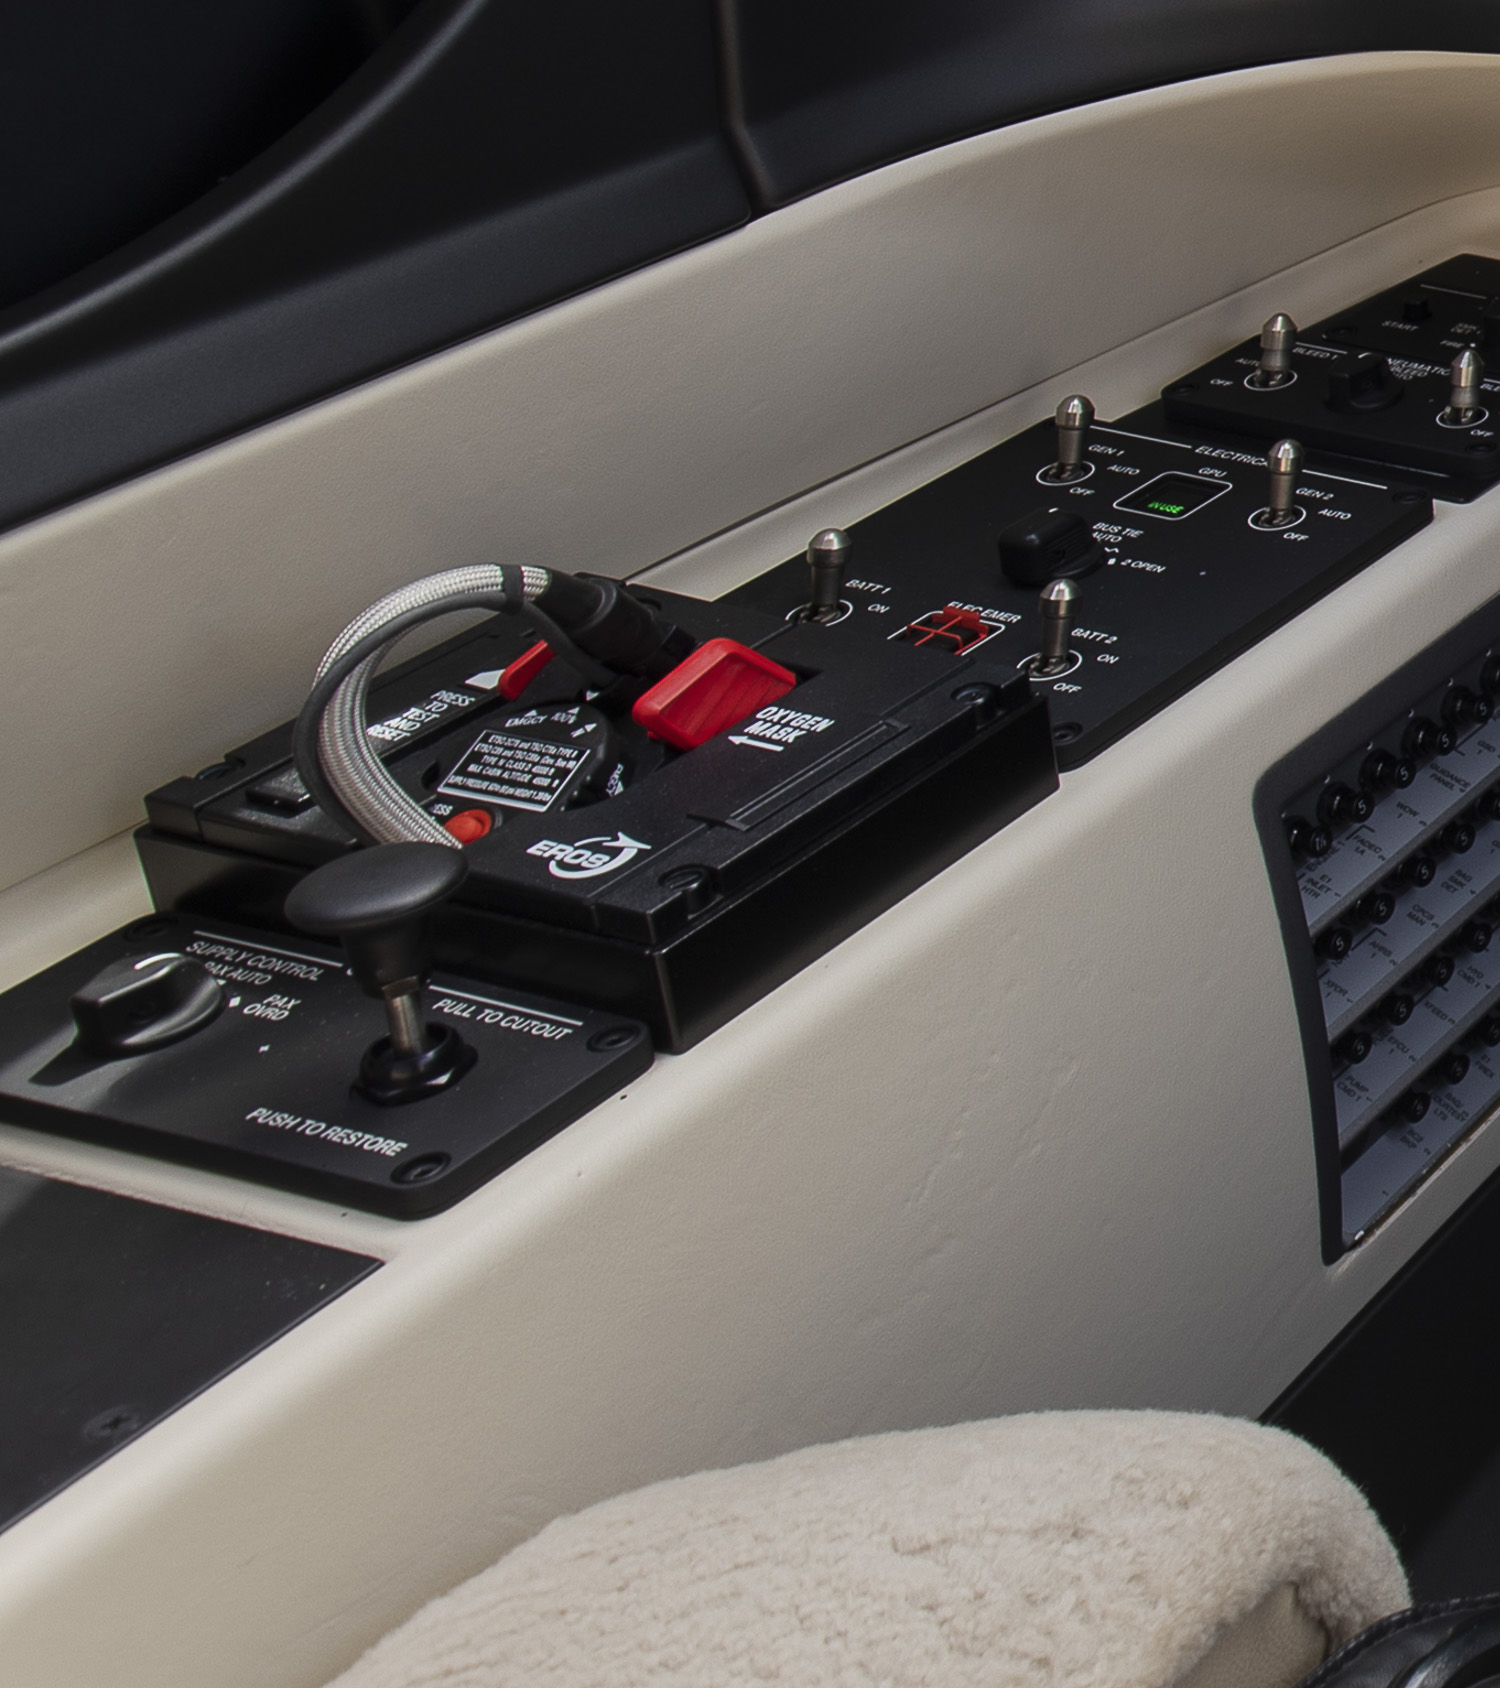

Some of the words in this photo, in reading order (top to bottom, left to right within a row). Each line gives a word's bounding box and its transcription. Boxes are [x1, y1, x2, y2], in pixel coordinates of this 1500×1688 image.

[1198, 467, 1227, 478] GPU
[743, 720, 804, 743] MASK
[755, 706, 834, 732] OXYGEN
[526, 840, 612, 868] EROS
[185, 941, 251, 965] SUPPLY
[248, 957, 327, 981] CONTROL
[432, 998, 478, 1018] PULL
[474, 1008, 504, 1024] TO
[500, 1014, 573, 1041] CUTOUT
[246, 1108, 303, 1133] PUSH
[294, 1119, 329, 1137] TO
[320, 1124, 408, 1157] RESTORE
